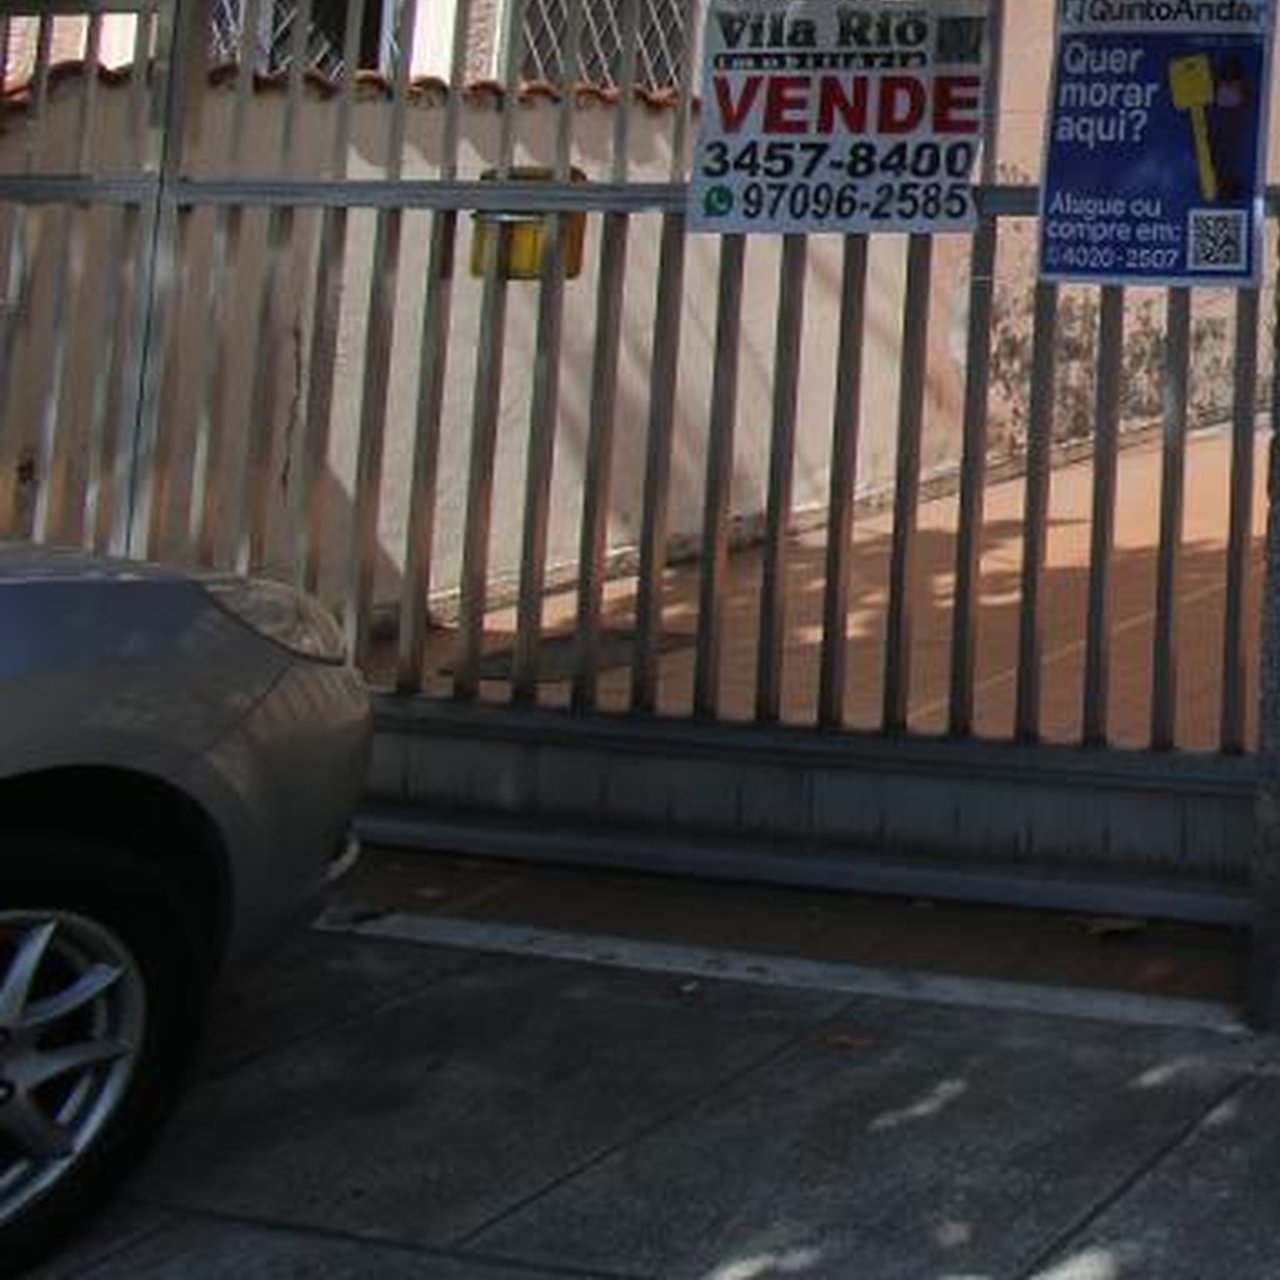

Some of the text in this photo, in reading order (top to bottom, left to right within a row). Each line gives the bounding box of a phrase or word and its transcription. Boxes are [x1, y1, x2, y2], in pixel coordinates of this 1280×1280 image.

[718, 7, 929, 49] Vila Rio
[1063, 41, 1144, 75] Quer
[713, 75, 981, 134] VENDE
[1058, 81, 1159, 108] morar
[1055, 109, 1148, 149] aqui?
[702, 141, 974, 178] 3457-8400
[742, 182, 968, 219] 97096-2585
[1049, 192, 1162, 220] Alugue ou
[1046, 221, 1131, 244] compre
